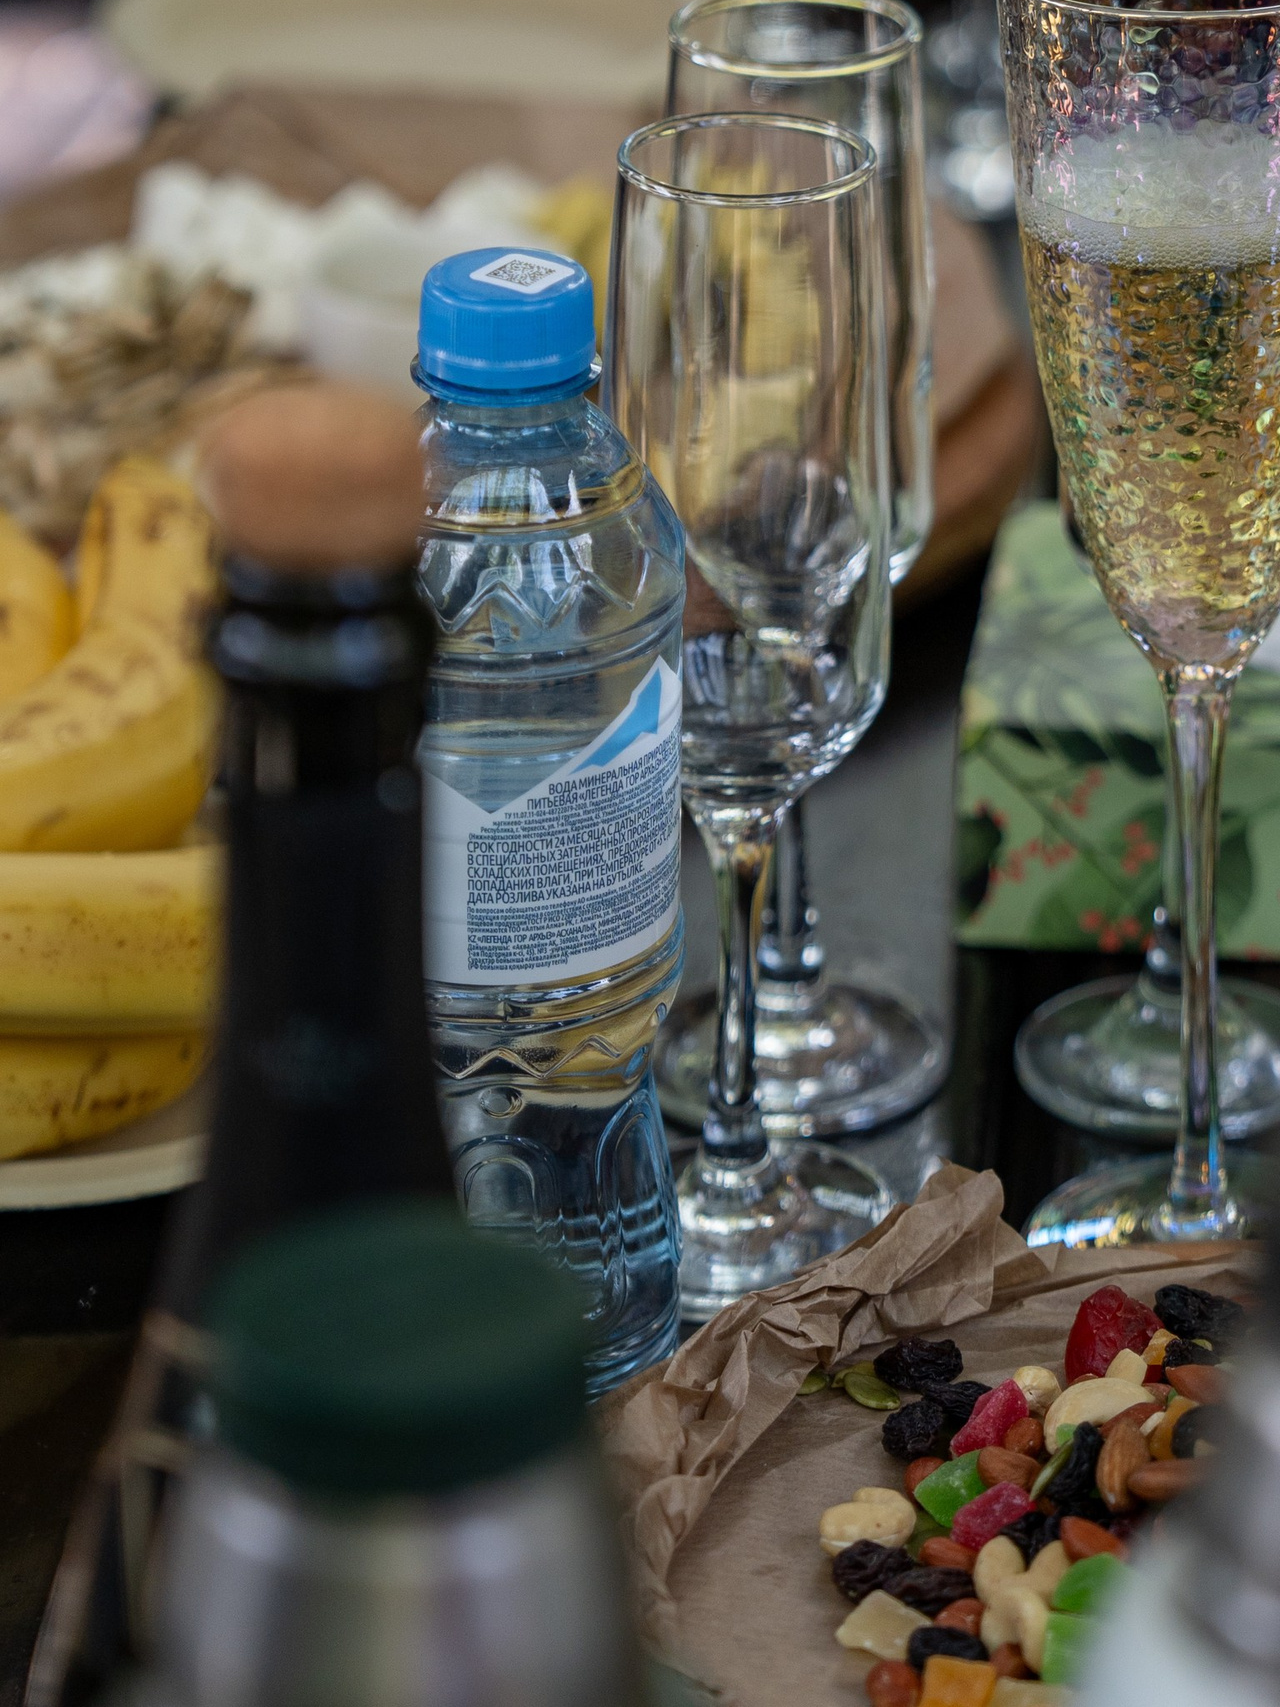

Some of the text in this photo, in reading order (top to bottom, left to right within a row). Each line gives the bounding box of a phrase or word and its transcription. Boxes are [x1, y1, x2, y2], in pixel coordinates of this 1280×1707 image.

[527, 792, 578, 810] ПИТЬЕВАЯ
[579, 779, 624, 802] «ЛЕГЕНДА
[626, 771, 640, 787] ГОР
[549, 780, 577, 795] ВОДА
[578, 757, 642, 789] МИНЕРАЛЬНАЯ
[466, 841, 494, 853] СРОК
[496, 838, 553, 854] ГОДНОСТИ
[554, 836, 566, 849] 24
[566, 826, 606, 846] МЕСЯЦА
[607, 824, 613, 836] С
[614, 814, 637, 836] ДАТЫ
[467, 854, 475, 865] В
[475, 850, 556, 868] СПЕЦИАЛЬНЫХ
[556, 832, 626, 860] ЗАТЕМНЕННЫХ
[467, 866, 532, 881] СКЛАДСКИХ
[533, 852, 607, 876] ПОМЕЩЕНИЯХ,
[467, 878, 535, 893] ПОПАДАНИЯ
[536, 874, 573, 889] ВЛАГИ,
[575, 868, 594, 882] ПРИ
[596, 847, 649, 877] ТЕМПЕРАТУРЕ
[467, 892, 494, 905] ДАТА
[495, 891, 546, 904] РОЗЛИВА
[546, 884, 592, 900] УКАЗАНА
[592, 876, 606, 891] НА
[606, 861, 646, 887] БУТЫЛКЕ.
[467, 935, 477, 943] KZ
[477, 935, 513, 944] «ЛЕГЕНДА
[513, 934, 528, 943] ГОР
